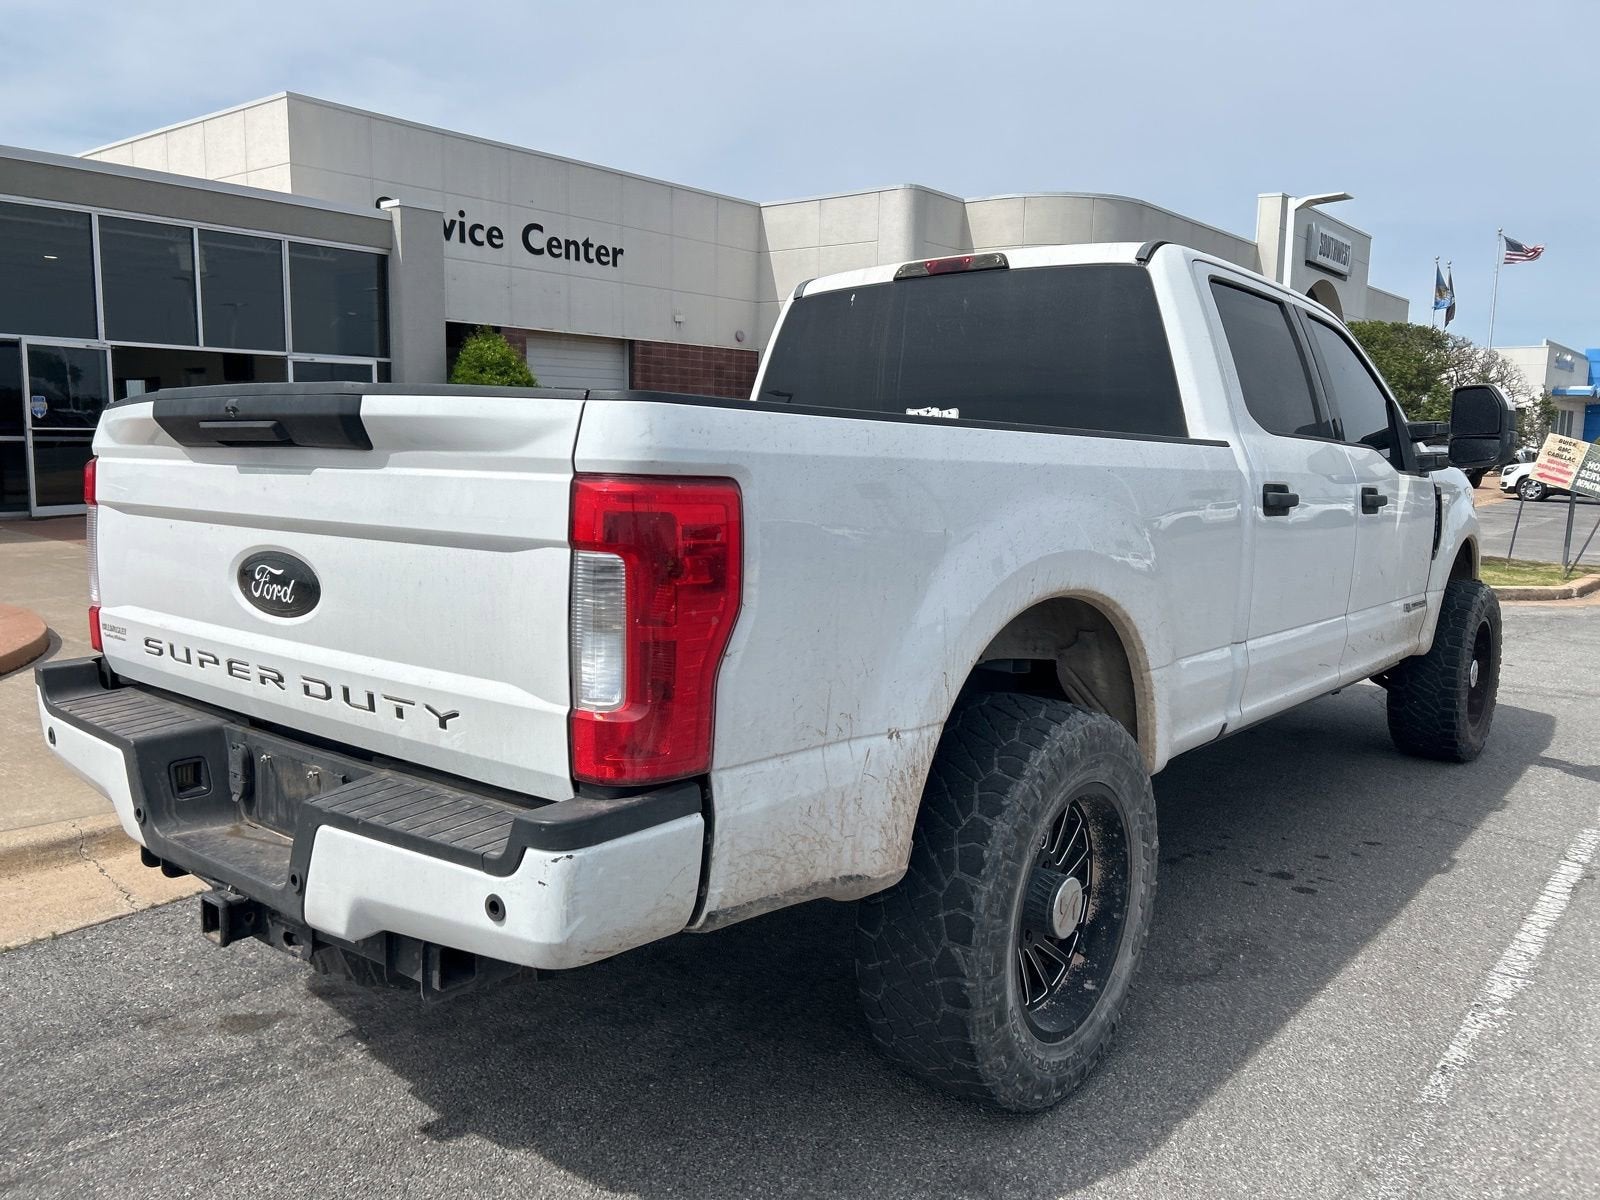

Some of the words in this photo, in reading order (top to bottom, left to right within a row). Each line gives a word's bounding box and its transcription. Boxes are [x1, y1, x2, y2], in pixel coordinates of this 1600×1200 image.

[521, 222, 624, 267] Center
[1547, 451, 1576, 463] CADILLAC
[1557, 446, 1572, 454] GMC
[251, 564, 295, 604] Ford
[143, 636, 287, 692] SUPER
[299, 674, 461, 731] DUTY
